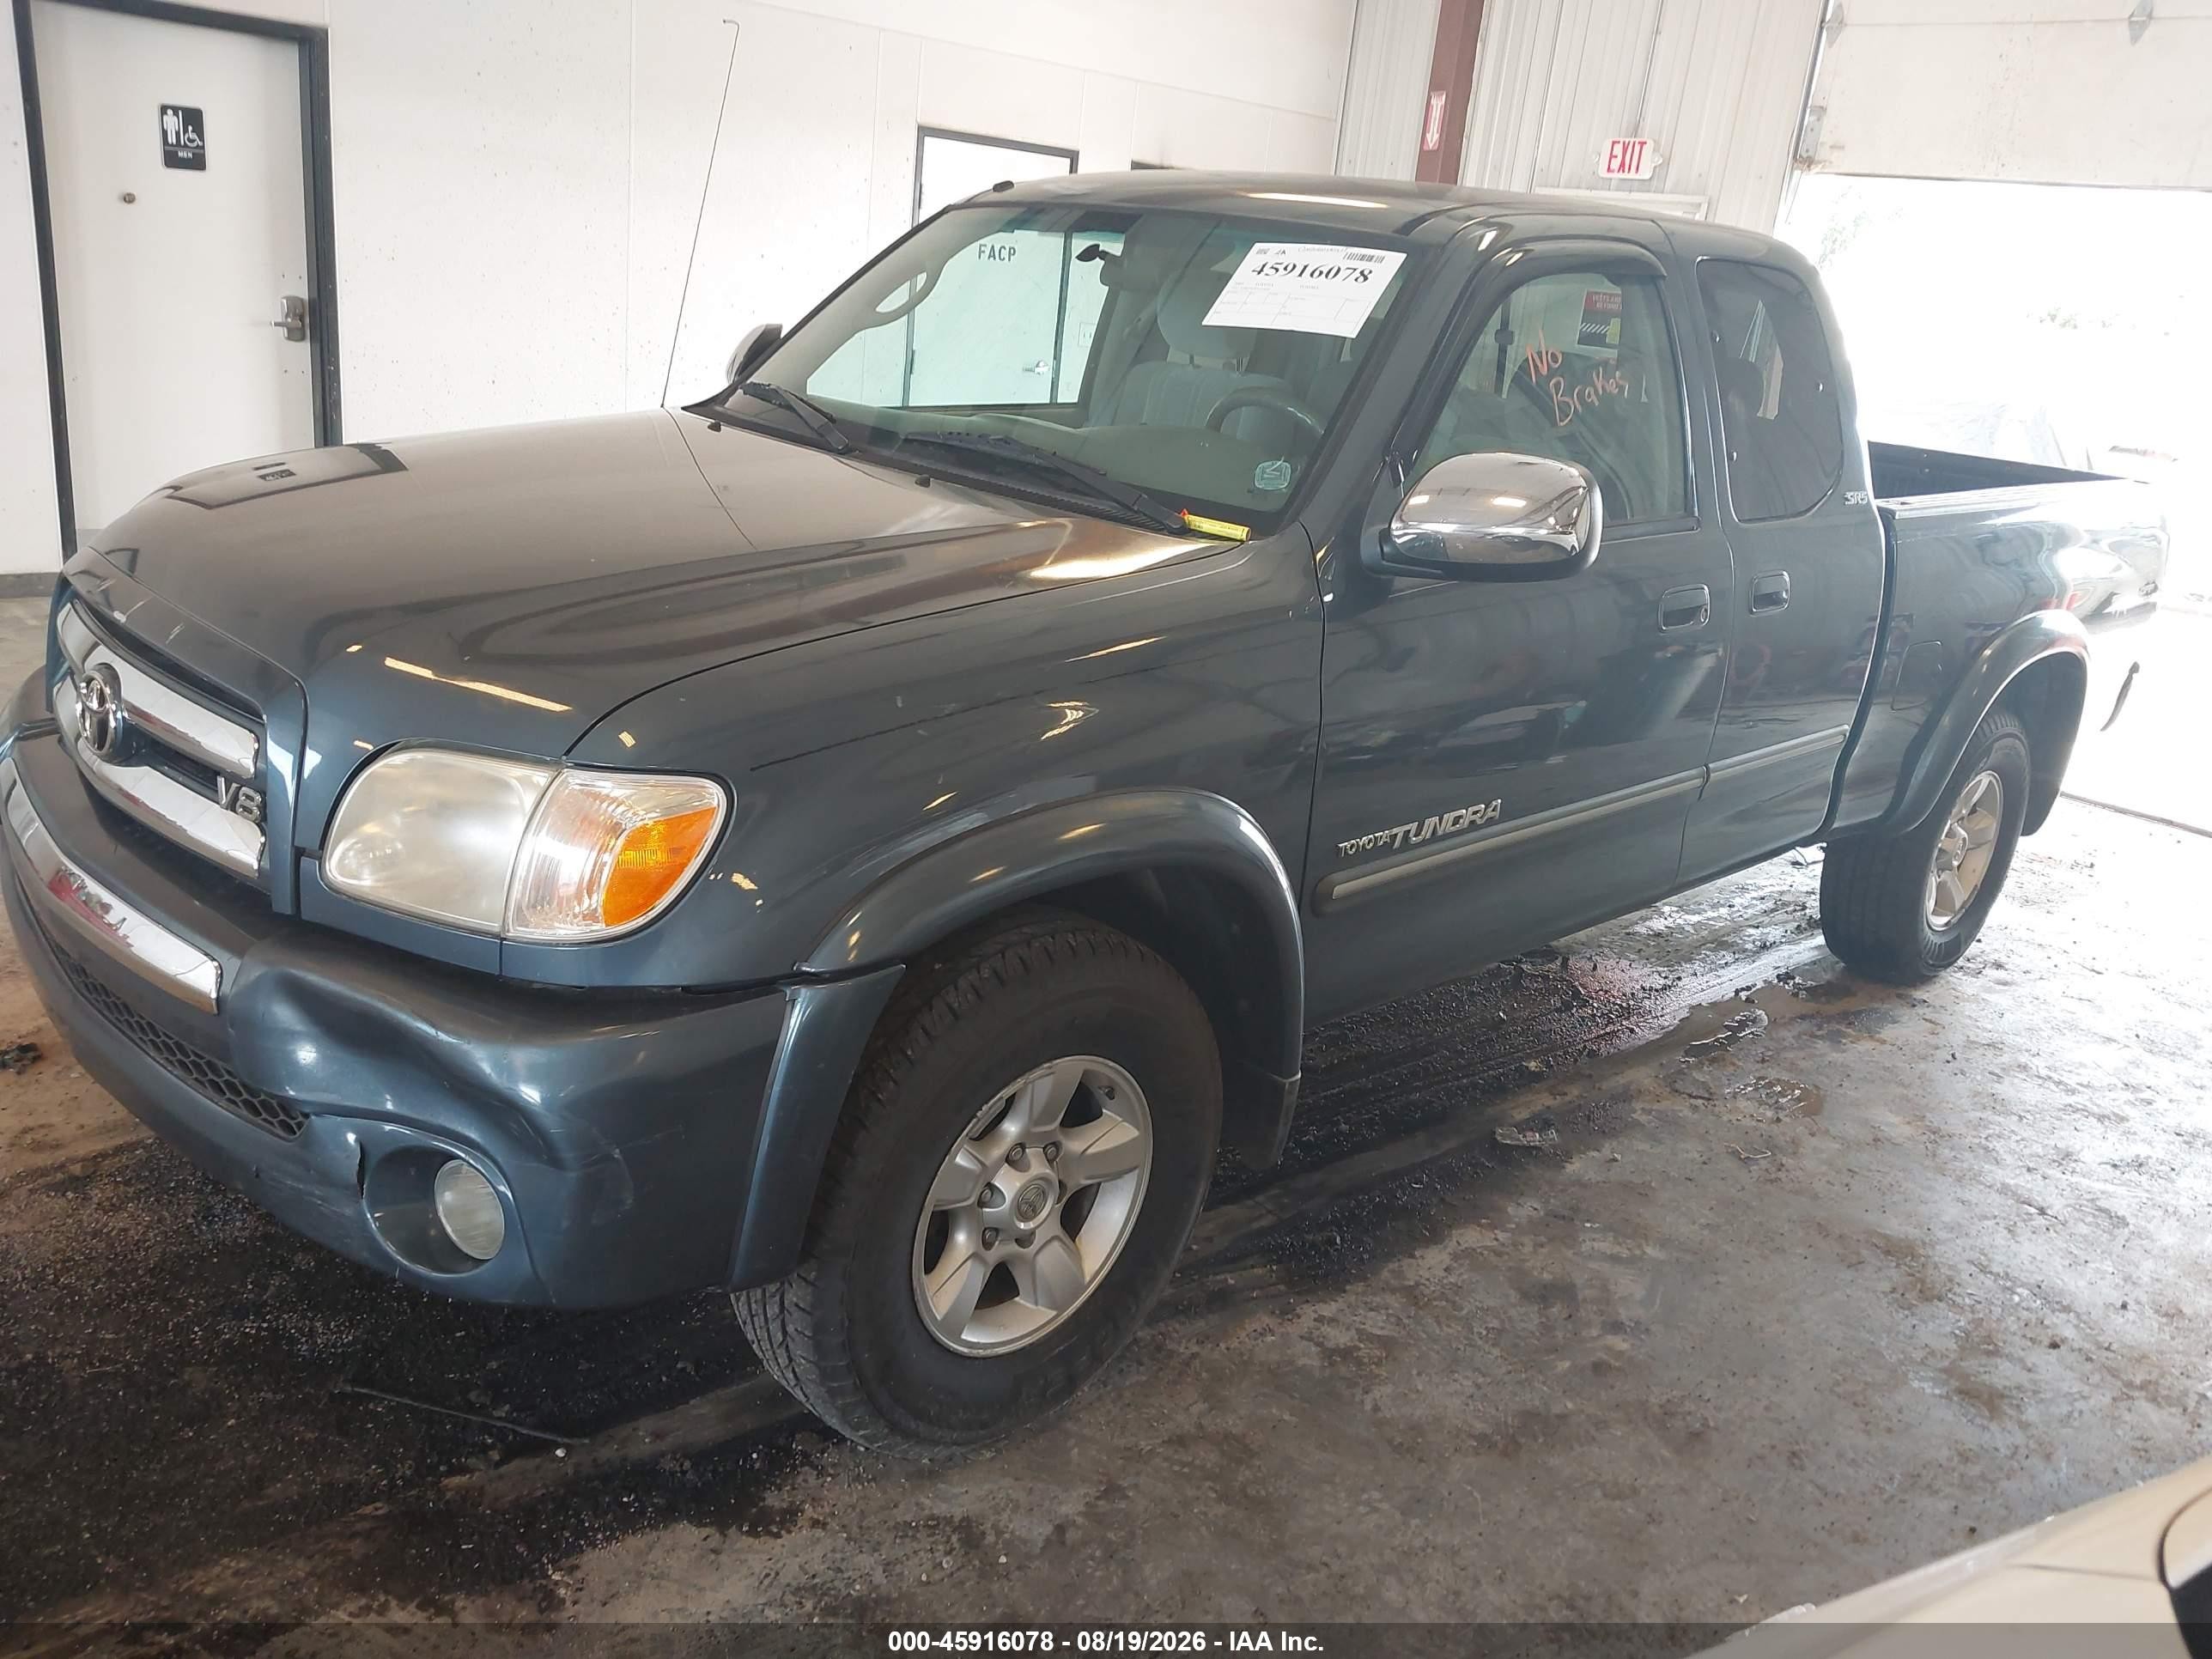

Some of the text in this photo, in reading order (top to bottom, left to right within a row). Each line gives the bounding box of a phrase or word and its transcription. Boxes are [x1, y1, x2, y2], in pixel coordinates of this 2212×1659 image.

[1607, 140, 1647, 173] EXIT
[978, 244, 1016, 261] FACP
[1251, 260, 1373, 283] 45916078
[1526, 330, 1563, 386] No
[1844, 490, 1868, 505] SR5
[217, 775, 262, 823] V8
[1337, 799, 1502, 857] TOYOTA TUNDRA
